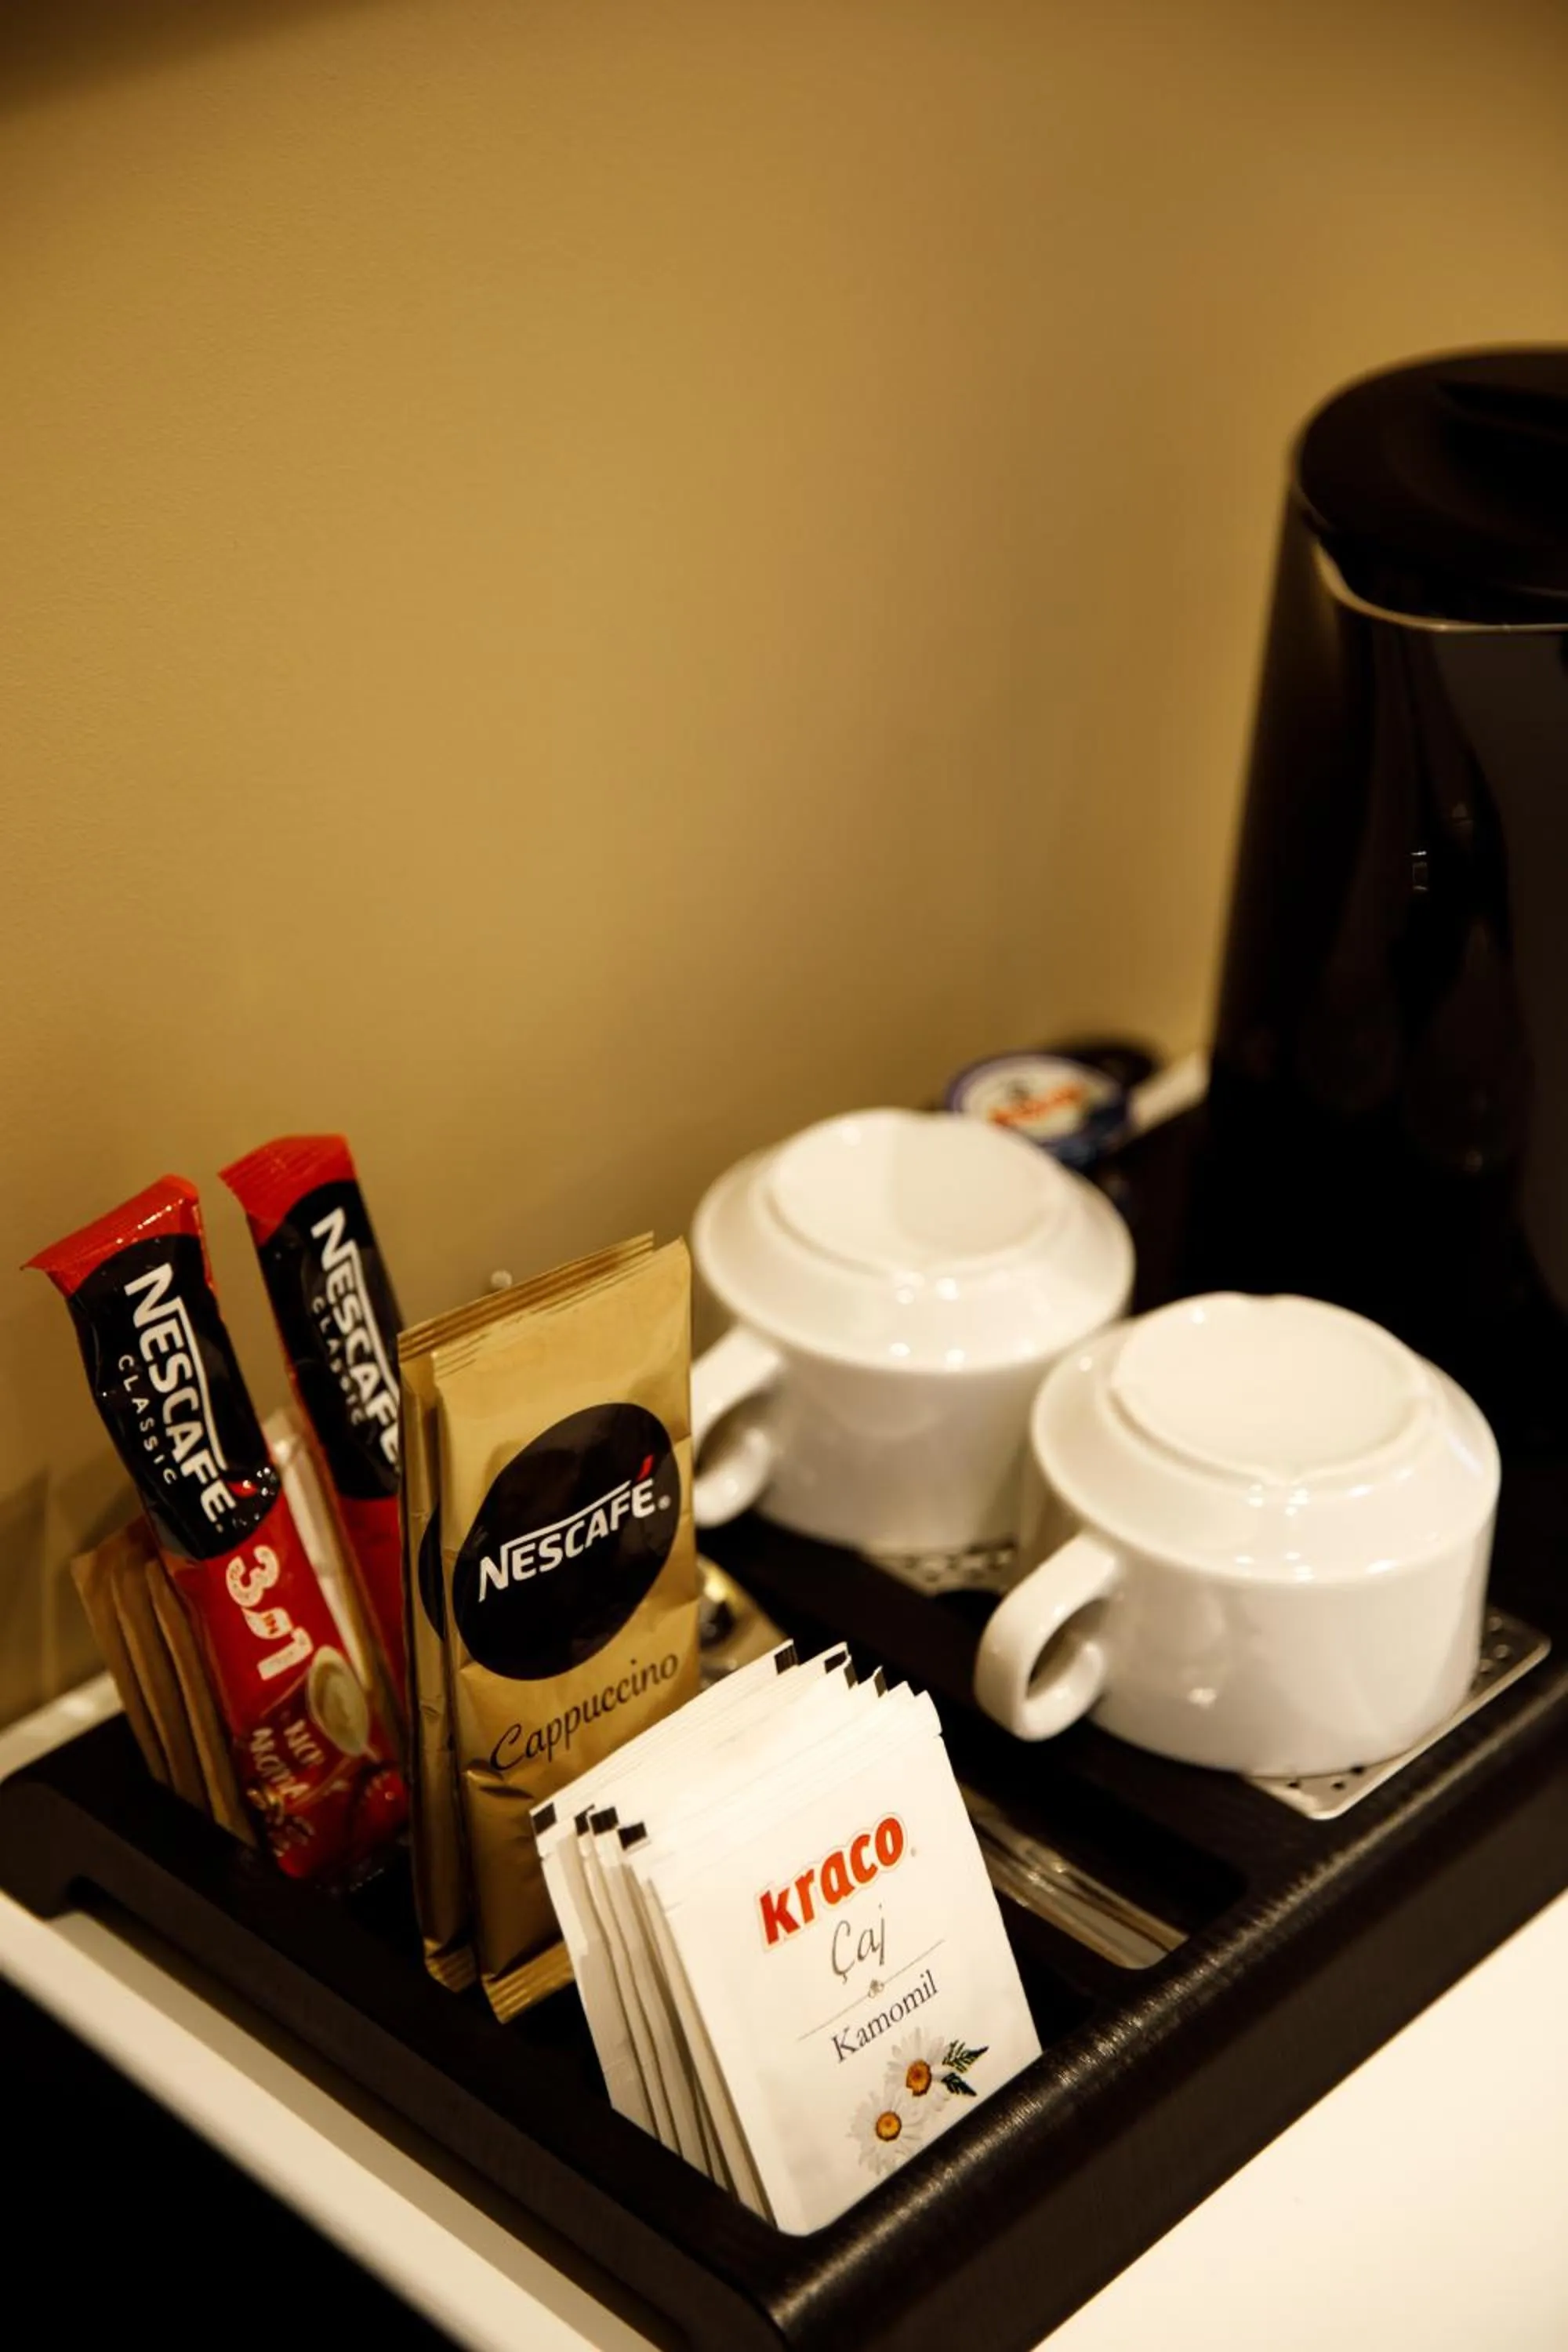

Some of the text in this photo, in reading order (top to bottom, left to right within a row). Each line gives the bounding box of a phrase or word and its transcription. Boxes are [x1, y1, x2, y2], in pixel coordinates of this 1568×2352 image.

[118, 1354, 178, 1486] CLASSIC
[311, 1297, 365, 1426] CLASSIC
[478, 1454, 655, 1603] NESCAFÉ
[488, 1653, 679, 1772] Cappuccino
[758, 1816, 905, 1946] kraco
[831, 1904, 886, 1984] Çaj
[830, 1969, 940, 2064] Kamomil
